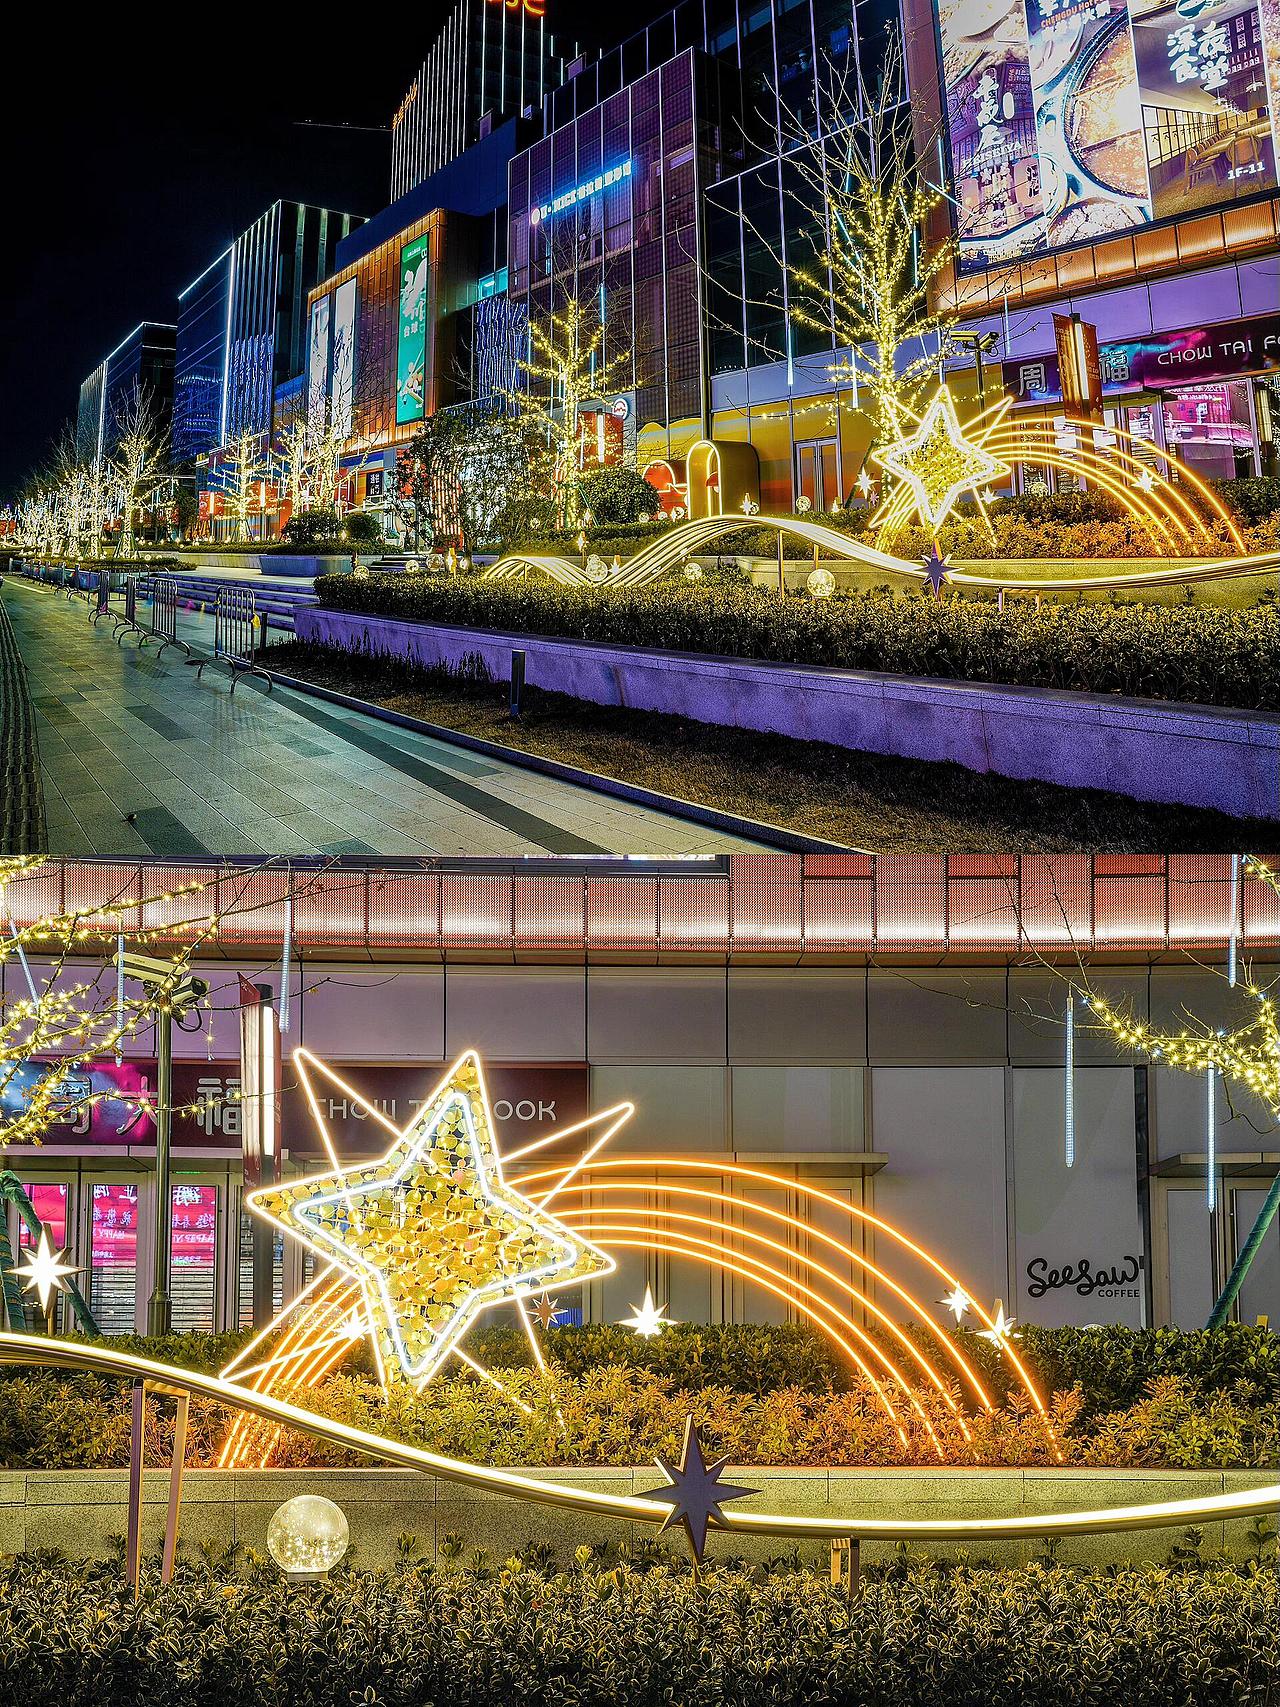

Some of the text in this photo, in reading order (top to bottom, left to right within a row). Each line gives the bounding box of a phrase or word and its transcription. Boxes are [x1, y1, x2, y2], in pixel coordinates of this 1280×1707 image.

[1040, 6, 1078, 28] CHENGDU
[1227, 161, 1266, 180] 1F-11
[1157, 345, 1213, 366] CHOW
[1218, 339, 1254, 356] TAI
[494, 1099, 558, 1121] OOK
[1098, 1289, 1140, 1298] COFFEE
